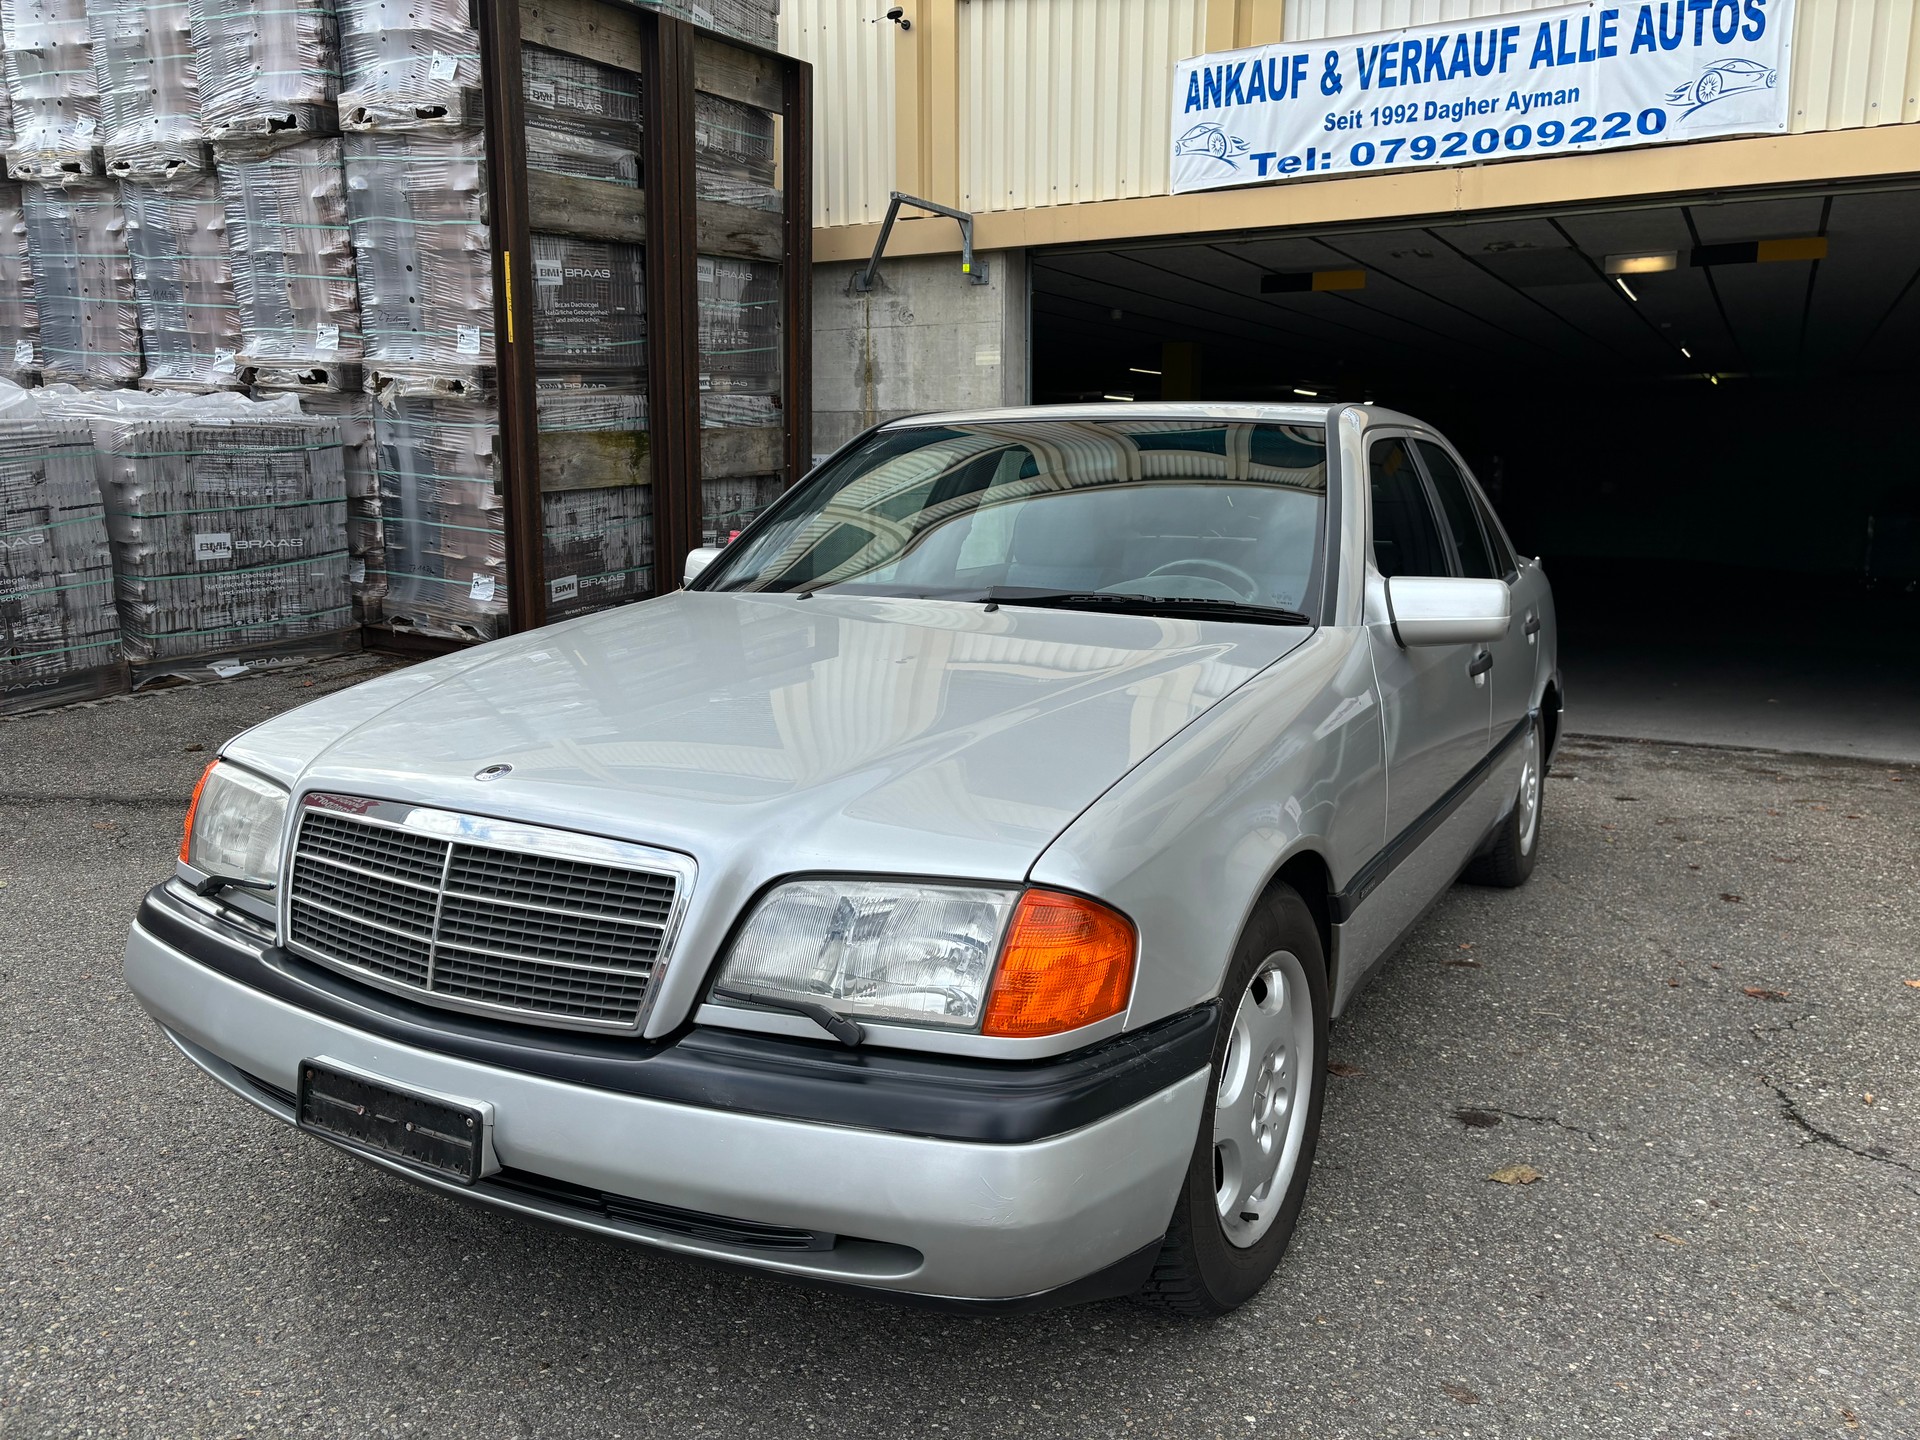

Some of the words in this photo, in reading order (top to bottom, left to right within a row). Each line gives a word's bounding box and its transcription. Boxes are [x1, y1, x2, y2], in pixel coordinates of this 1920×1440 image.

[1184, 55, 1307, 113] ANKAUF
[1320, 50, 1343, 95] &
[1358, 26, 1520, 90] VERKAUF
[1529, 9, 1618, 69] ALLE
[1630, 0, 1766, 54] AUTOS
[557, 95, 604, 114] BRAAS
[1324, 110, 1363, 132] Seit
[1370, 104, 1419, 129] 1992
[1424, 96, 1500, 129] Dagher
[1505, 86, 1580, 119] Ayman
[1249, 147, 1332, 177] Tel:
[1350, 107, 1668, 167] 0792009220
[540, 268, 560, 277] BMI
[564, 268, 611, 278] BRAAS
[715, 268, 753, 281] BRAAS
[235, 538, 303, 549] BRAAS
[555, 582, 575, 594] BMI
[580, 572, 626, 588] BRAAS
